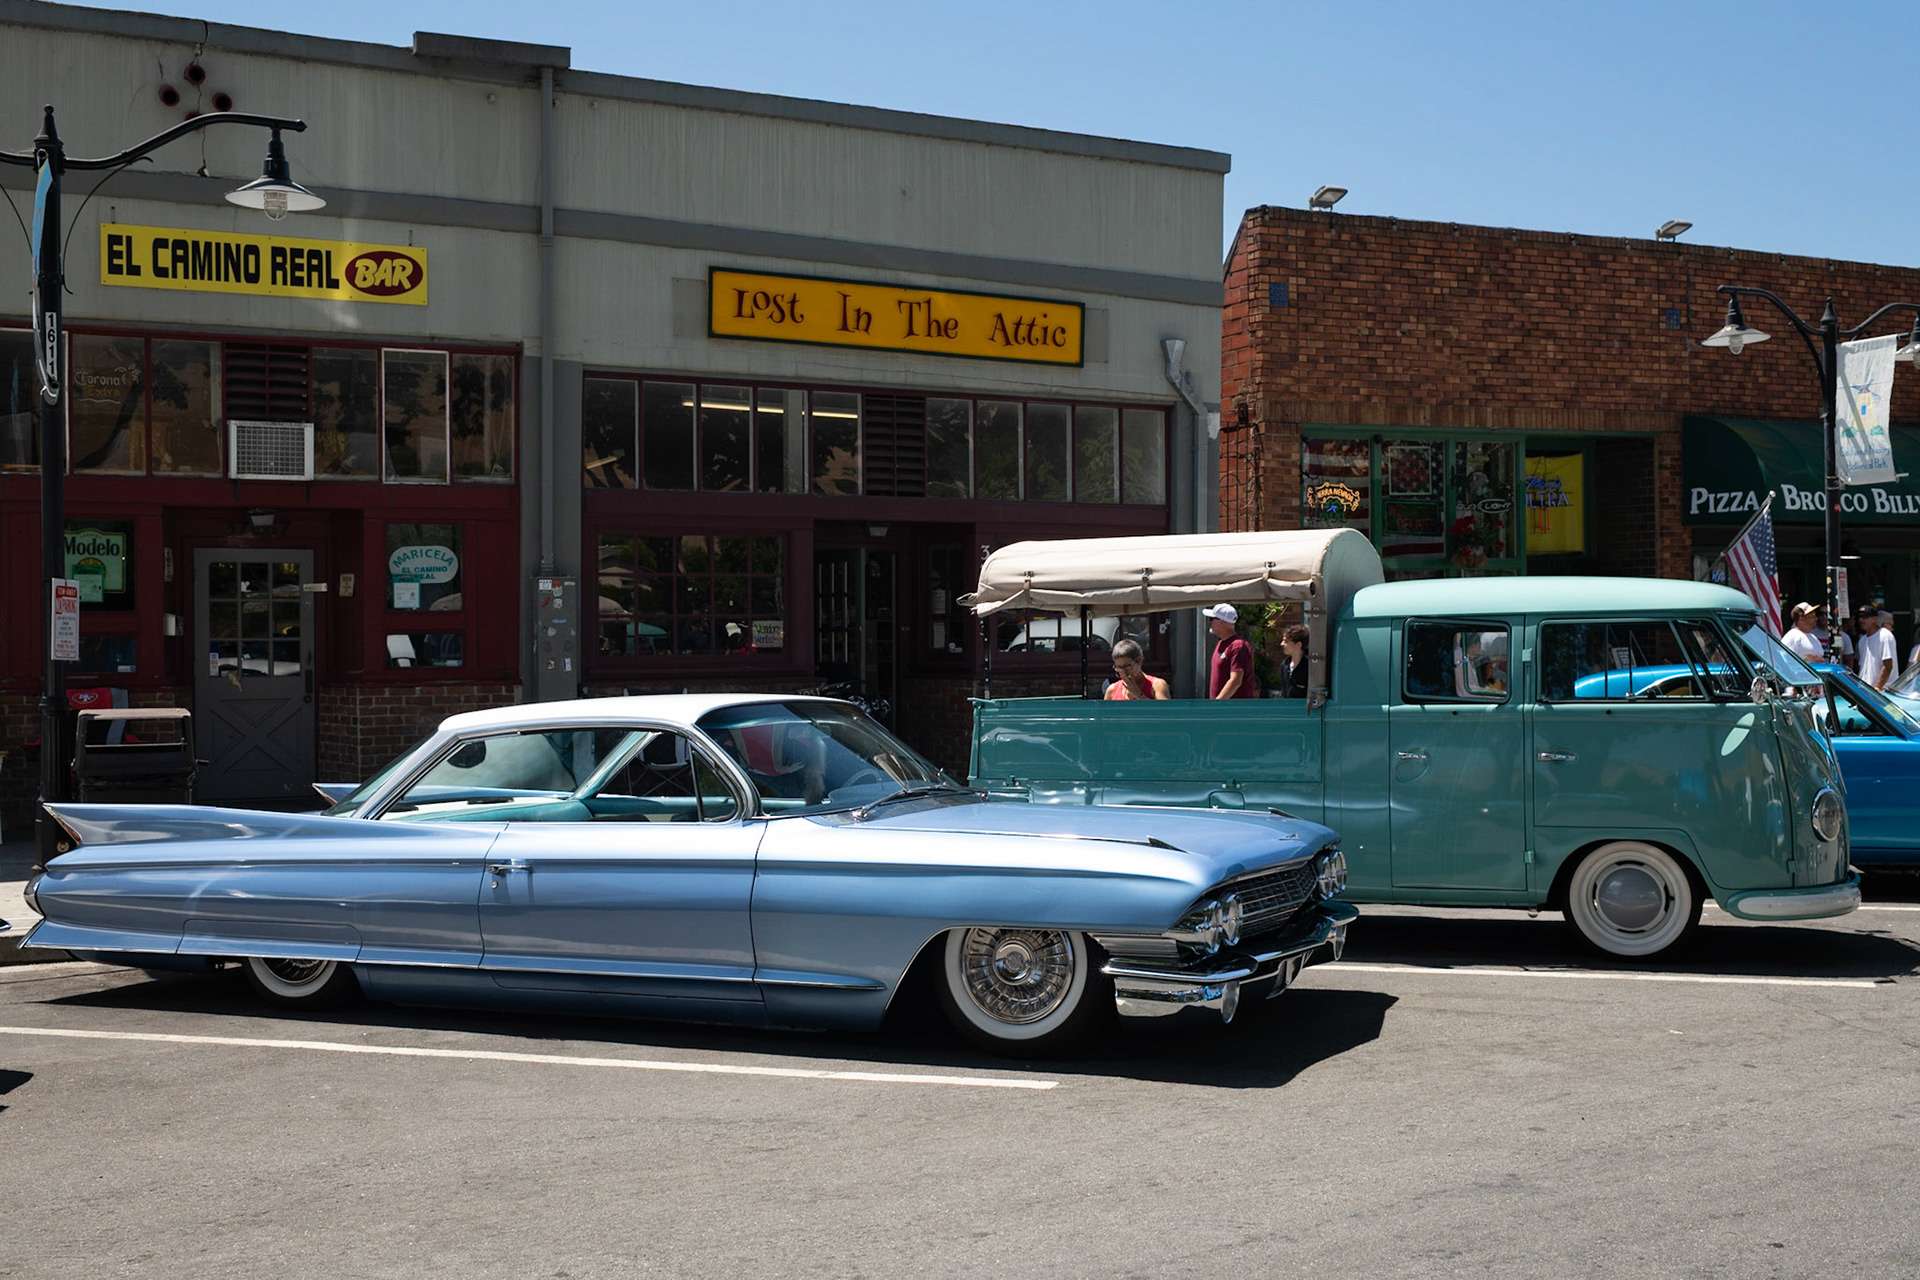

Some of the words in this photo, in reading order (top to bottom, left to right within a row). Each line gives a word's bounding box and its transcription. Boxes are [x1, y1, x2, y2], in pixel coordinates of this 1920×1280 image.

[107, 234, 141, 277] EL
[152, 237, 260, 284] CAMINO
[271, 246, 340, 289] REAL
[354, 258, 414, 290] BAR
[732, 287, 804, 324] Lost
[836, 291, 872, 336] In
[897, 297, 959, 340] The
[987, 312, 1066, 347] Attic
[48, 313, 56, 381] 1611
[74, 370, 120, 386] Corona
[1689, 487, 1760, 514] PIZZA
[1780, 484, 1868, 512] BROCO
[64, 536, 120, 556] Modelo
[393, 548, 454, 568] MARICELA
